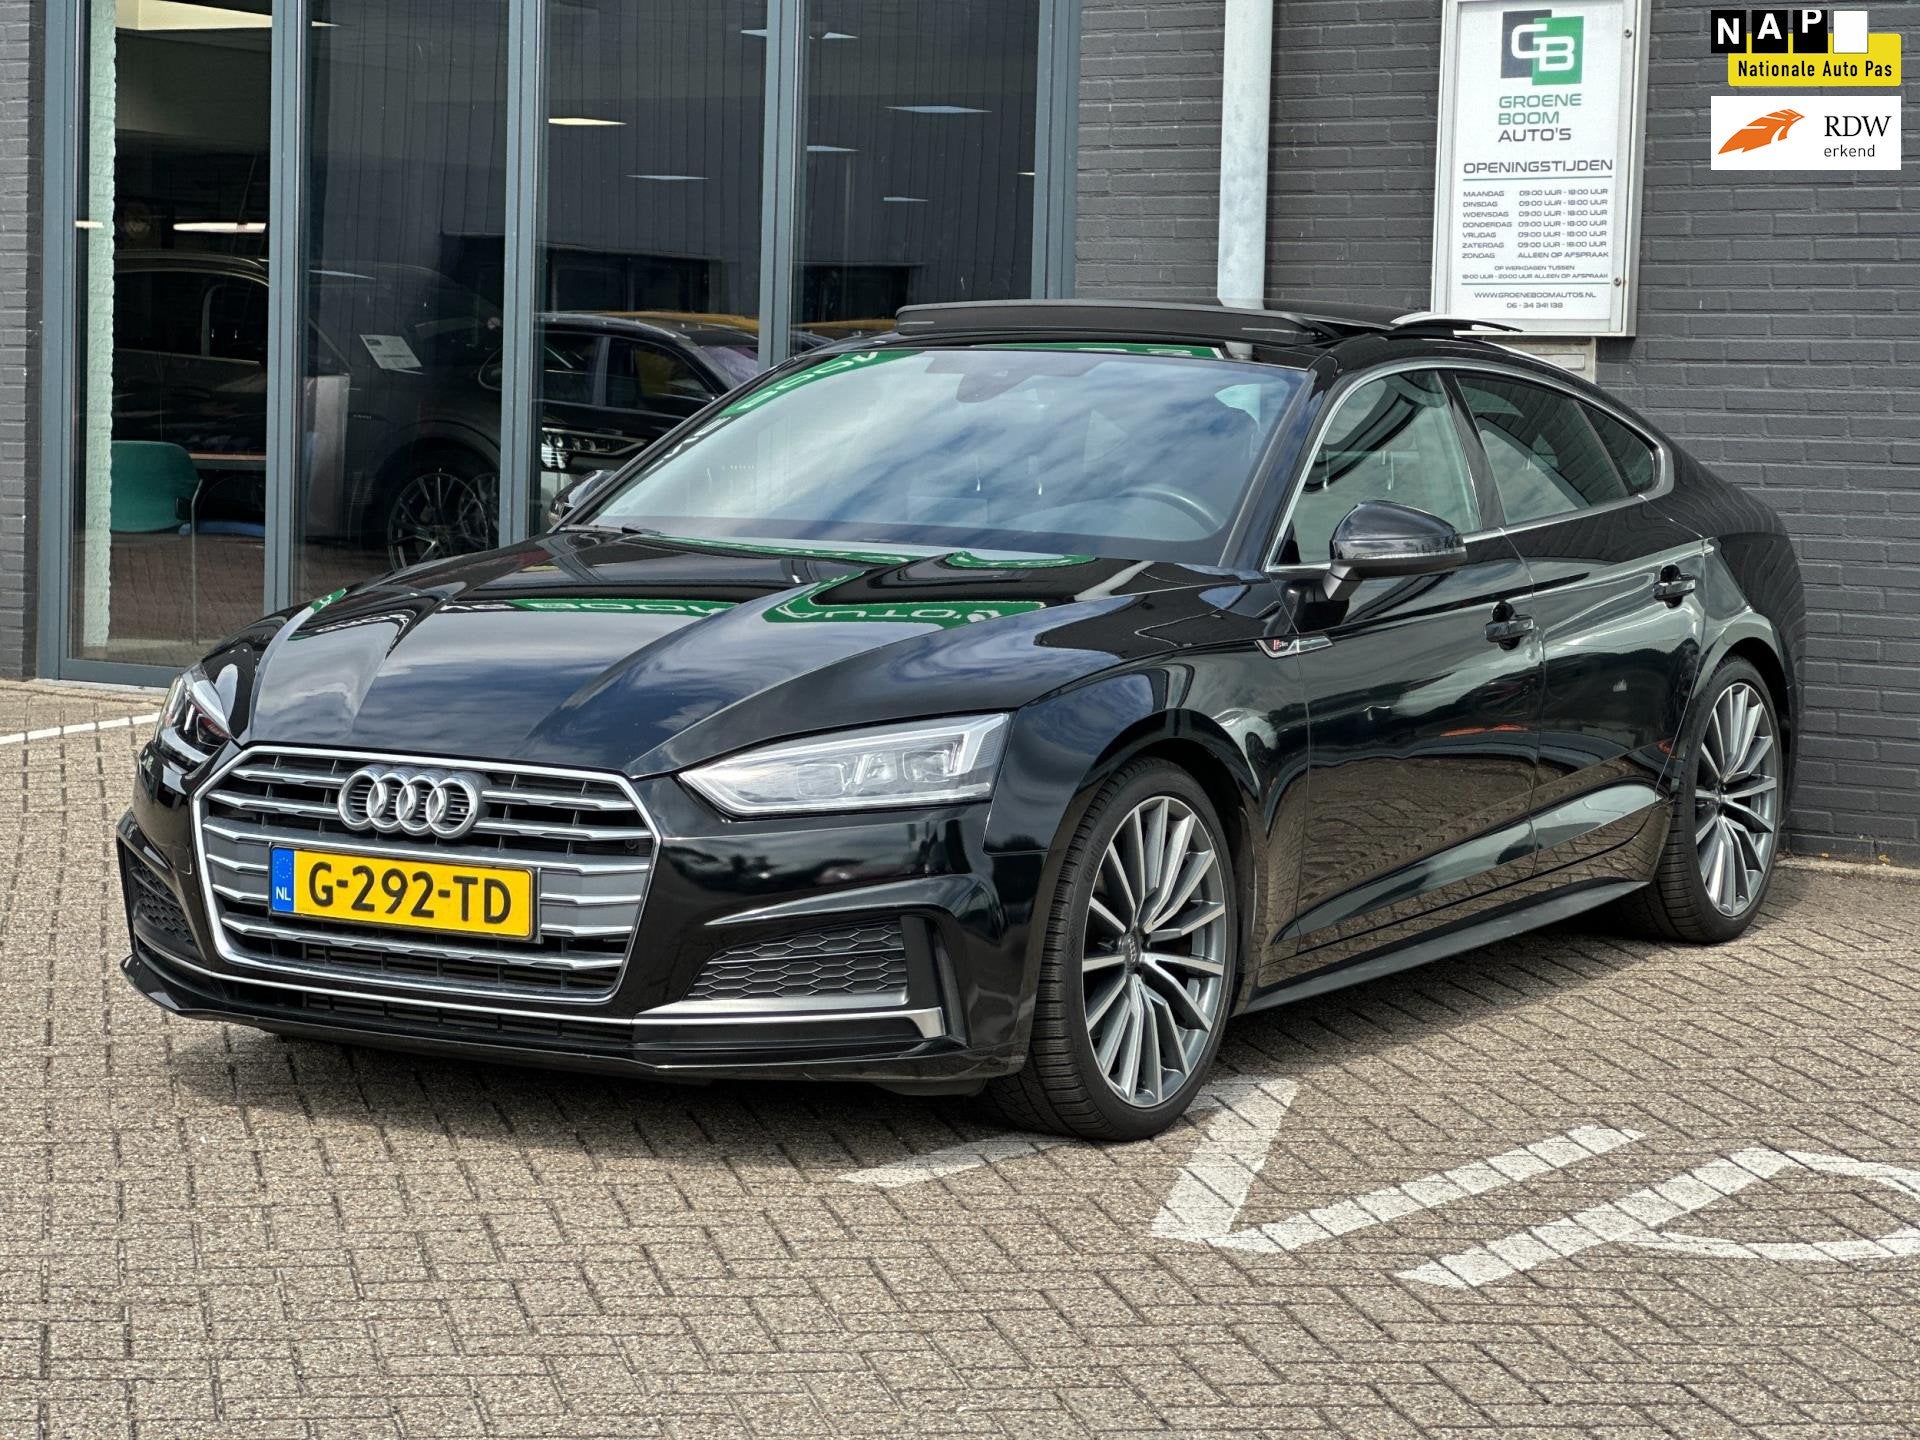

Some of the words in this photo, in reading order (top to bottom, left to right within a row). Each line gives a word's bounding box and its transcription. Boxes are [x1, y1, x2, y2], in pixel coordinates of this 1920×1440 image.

[1499, 93, 1582, 109] GROENE
[1498, 110, 1560, 126] BOOM
[1498, 127, 1572, 143] AUTO'S
[1463, 159, 1613, 174] OPENINGSTIJDEN
[1519, 189, 1543, 197] 09:00
[275, 886, 292, 902] NL
[309, 861, 512, 924] G-292-TD
